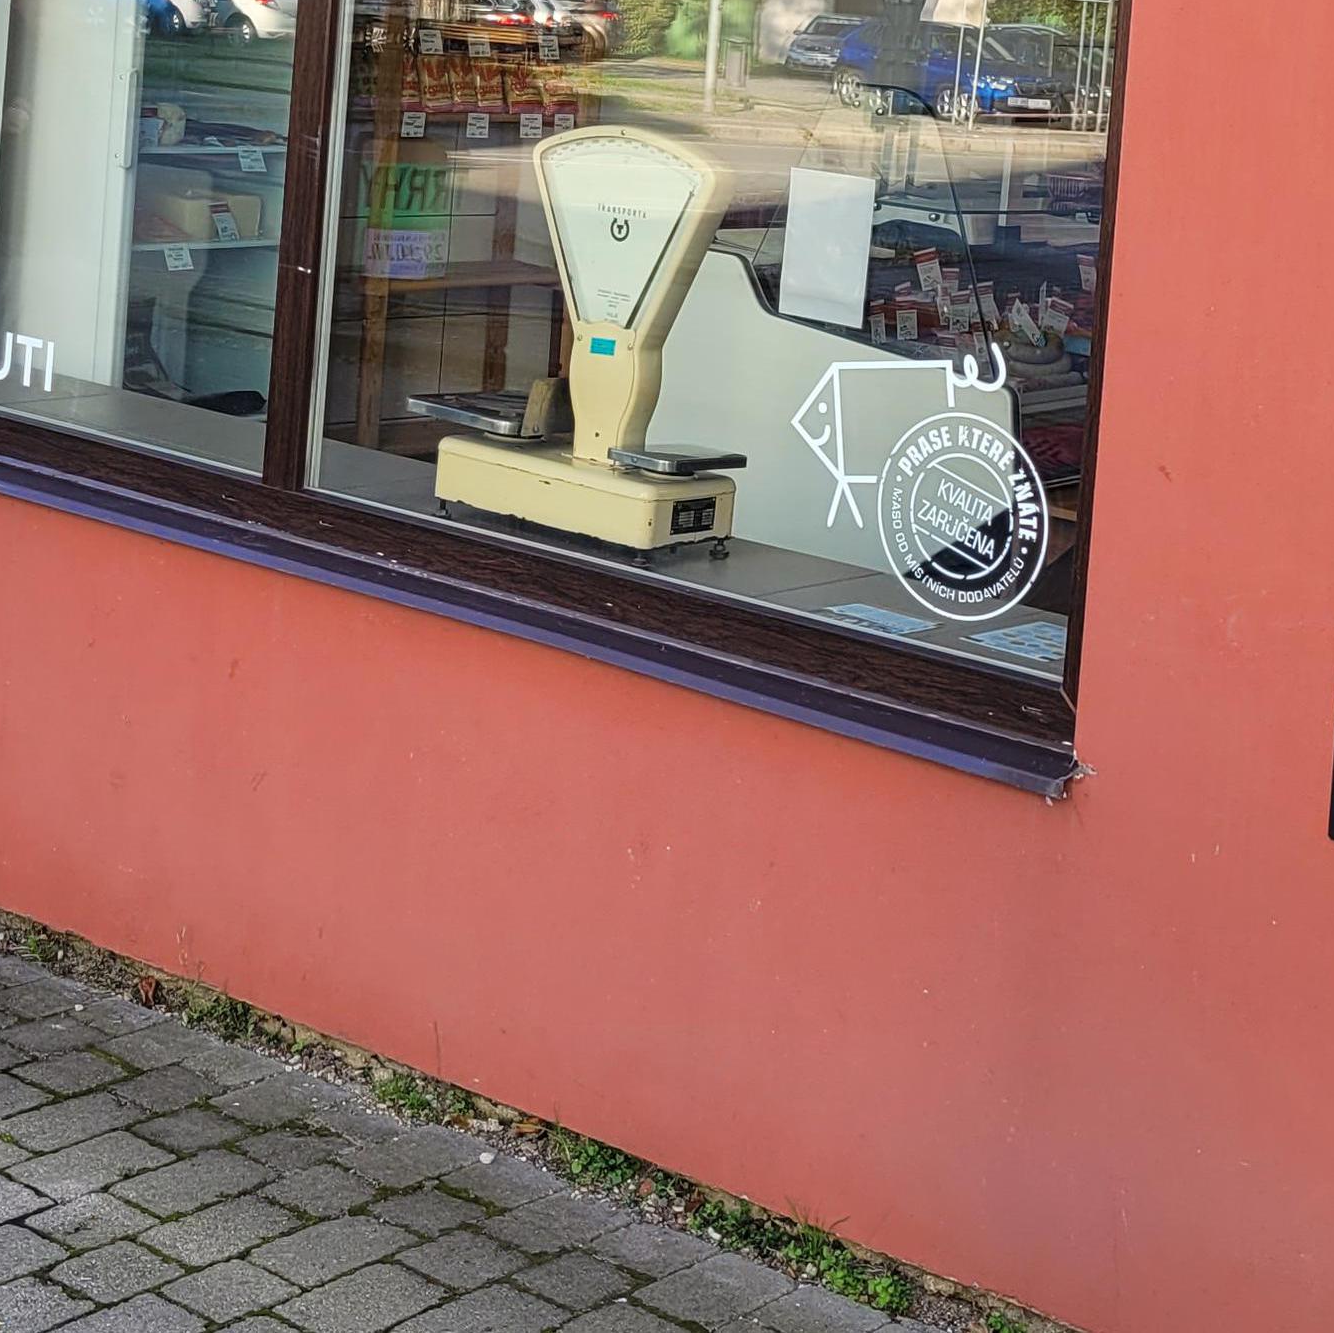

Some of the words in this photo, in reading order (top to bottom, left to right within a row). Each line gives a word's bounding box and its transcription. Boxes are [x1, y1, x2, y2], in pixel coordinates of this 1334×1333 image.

[898, 425, 952, 477] PRASE
[958, 424, 1016, 471] KTERÉ
[1007, 467, 1040, 543] ZNÁTE
[937, 478, 994, 526] KVALITA
[891, 487, 903, 529] MASO
[916, 499, 996, 560] ZARUČENA
[895, 533, 909, 553] OD
[958, 556, 1025, 603] DODAVATELŮ
